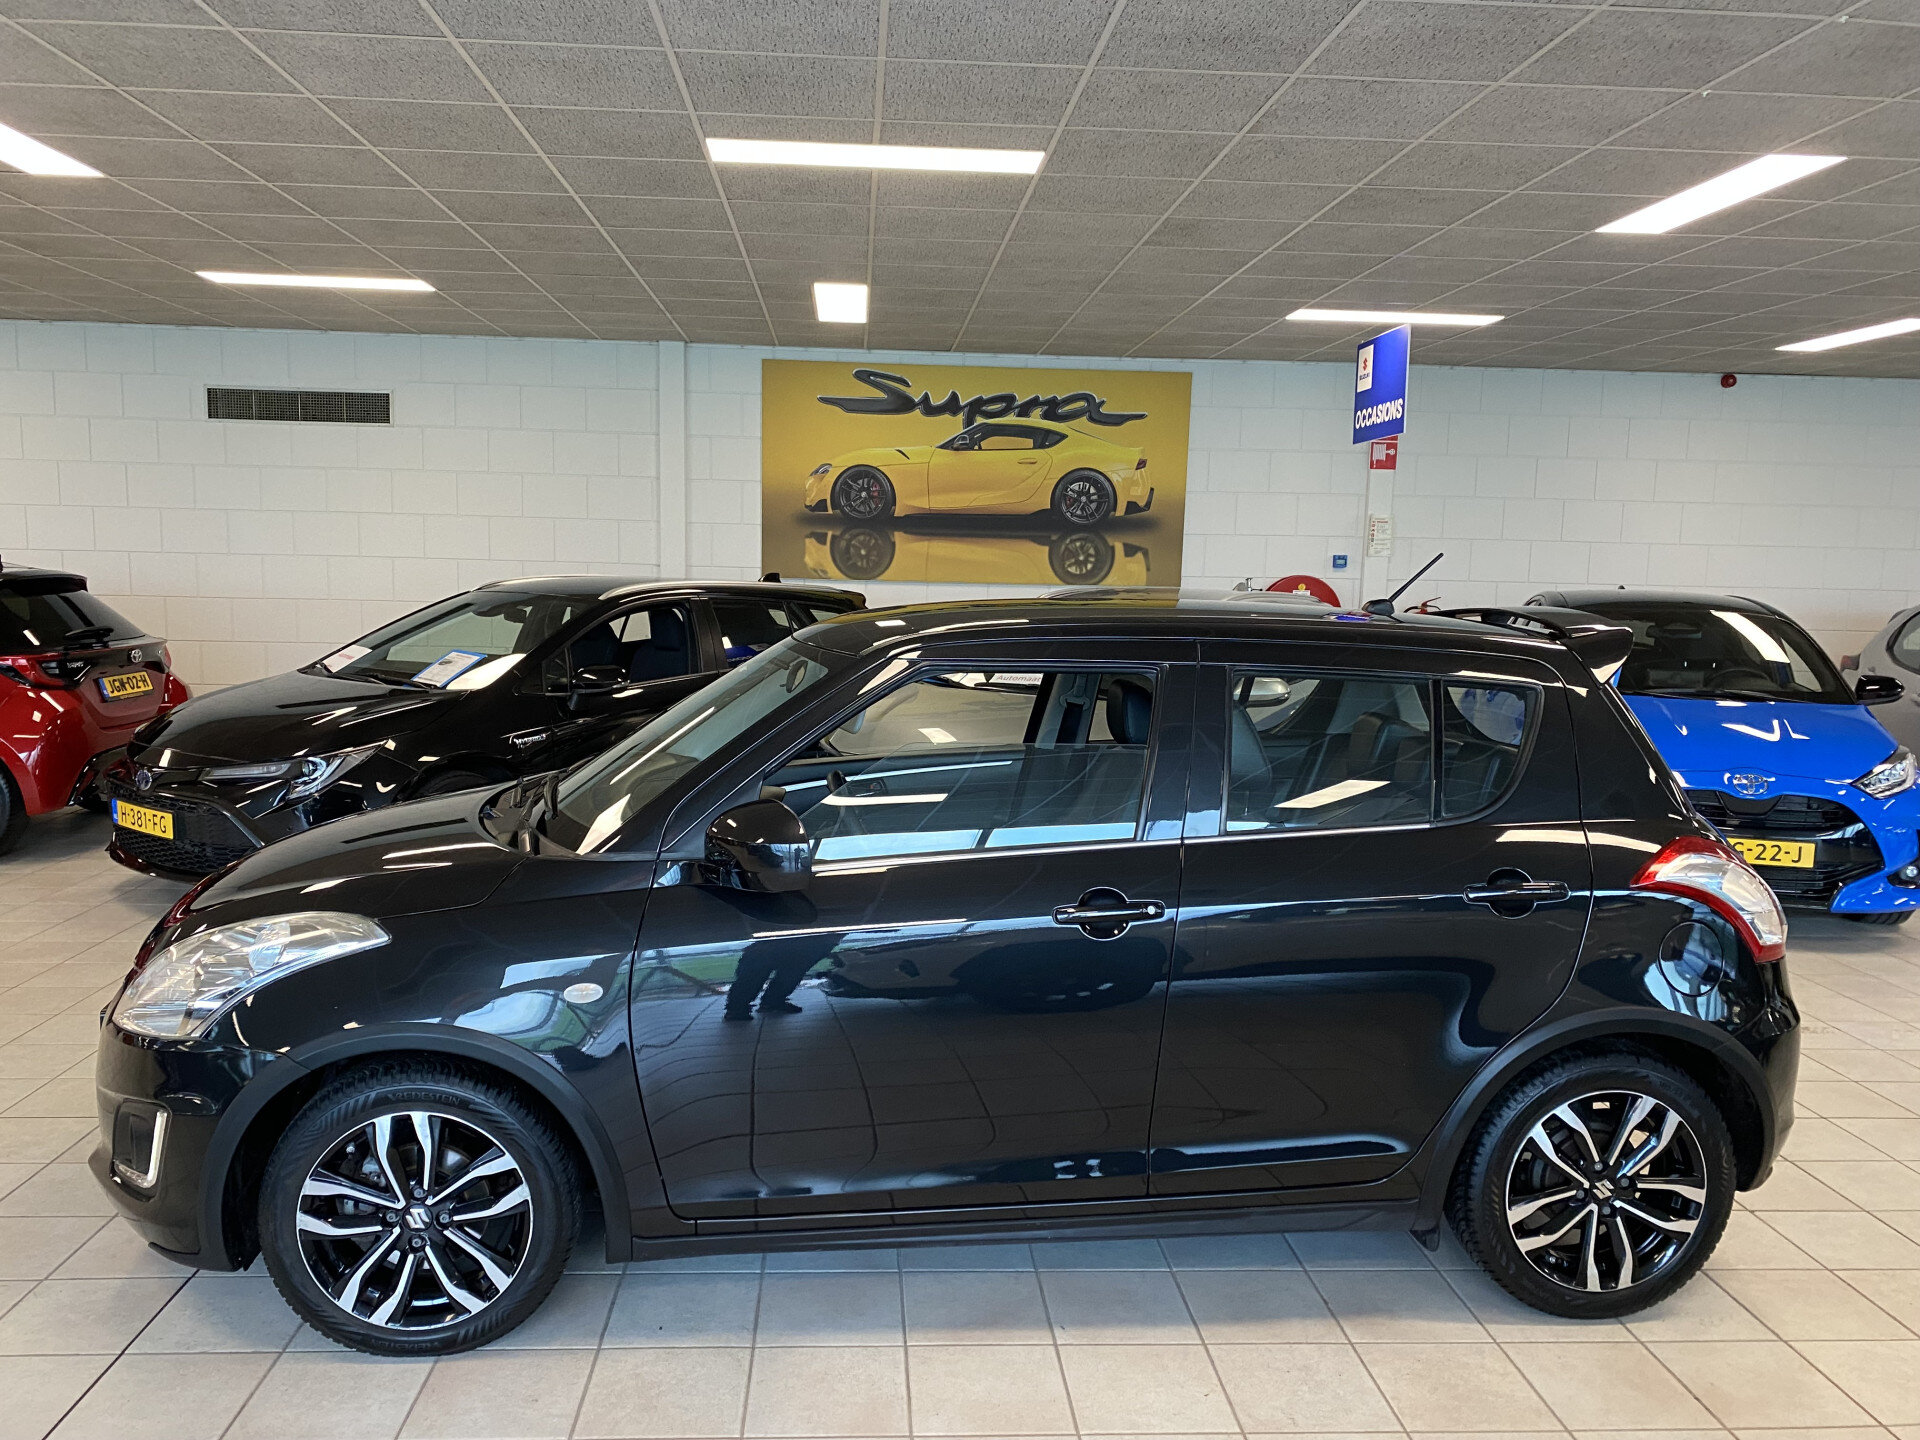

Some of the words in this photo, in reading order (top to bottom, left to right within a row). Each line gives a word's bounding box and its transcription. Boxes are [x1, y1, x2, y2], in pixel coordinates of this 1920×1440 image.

[817, 368, 1148, 429] Supra
[1355, 398, 1404, 430] OCCASIONS
[120, 805, 167, 834] H-381-FG
